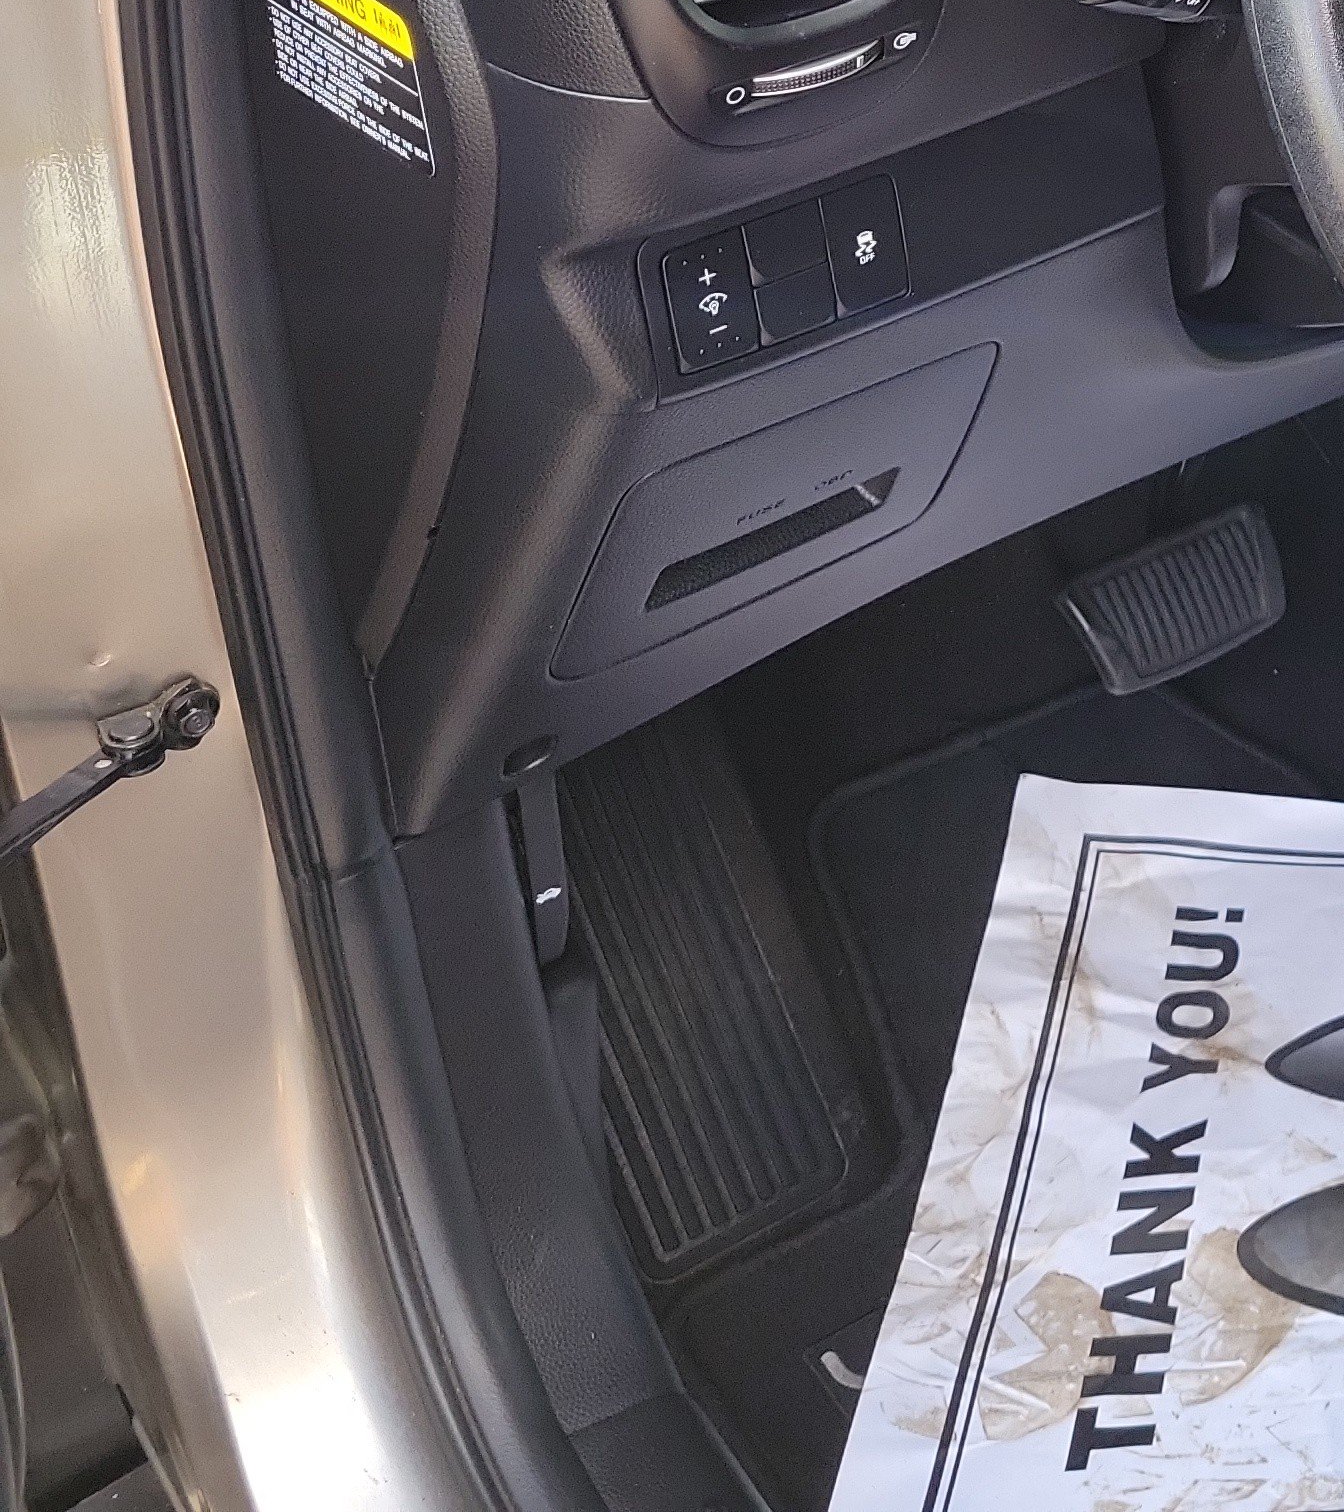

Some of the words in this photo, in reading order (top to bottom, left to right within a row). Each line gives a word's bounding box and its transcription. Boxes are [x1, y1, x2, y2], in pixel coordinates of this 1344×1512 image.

[858, 252, 876, 265] OFF
[1064, 1118, 1209, 1472] THANK
[1139, 905, 1245, 1094] YOU!
